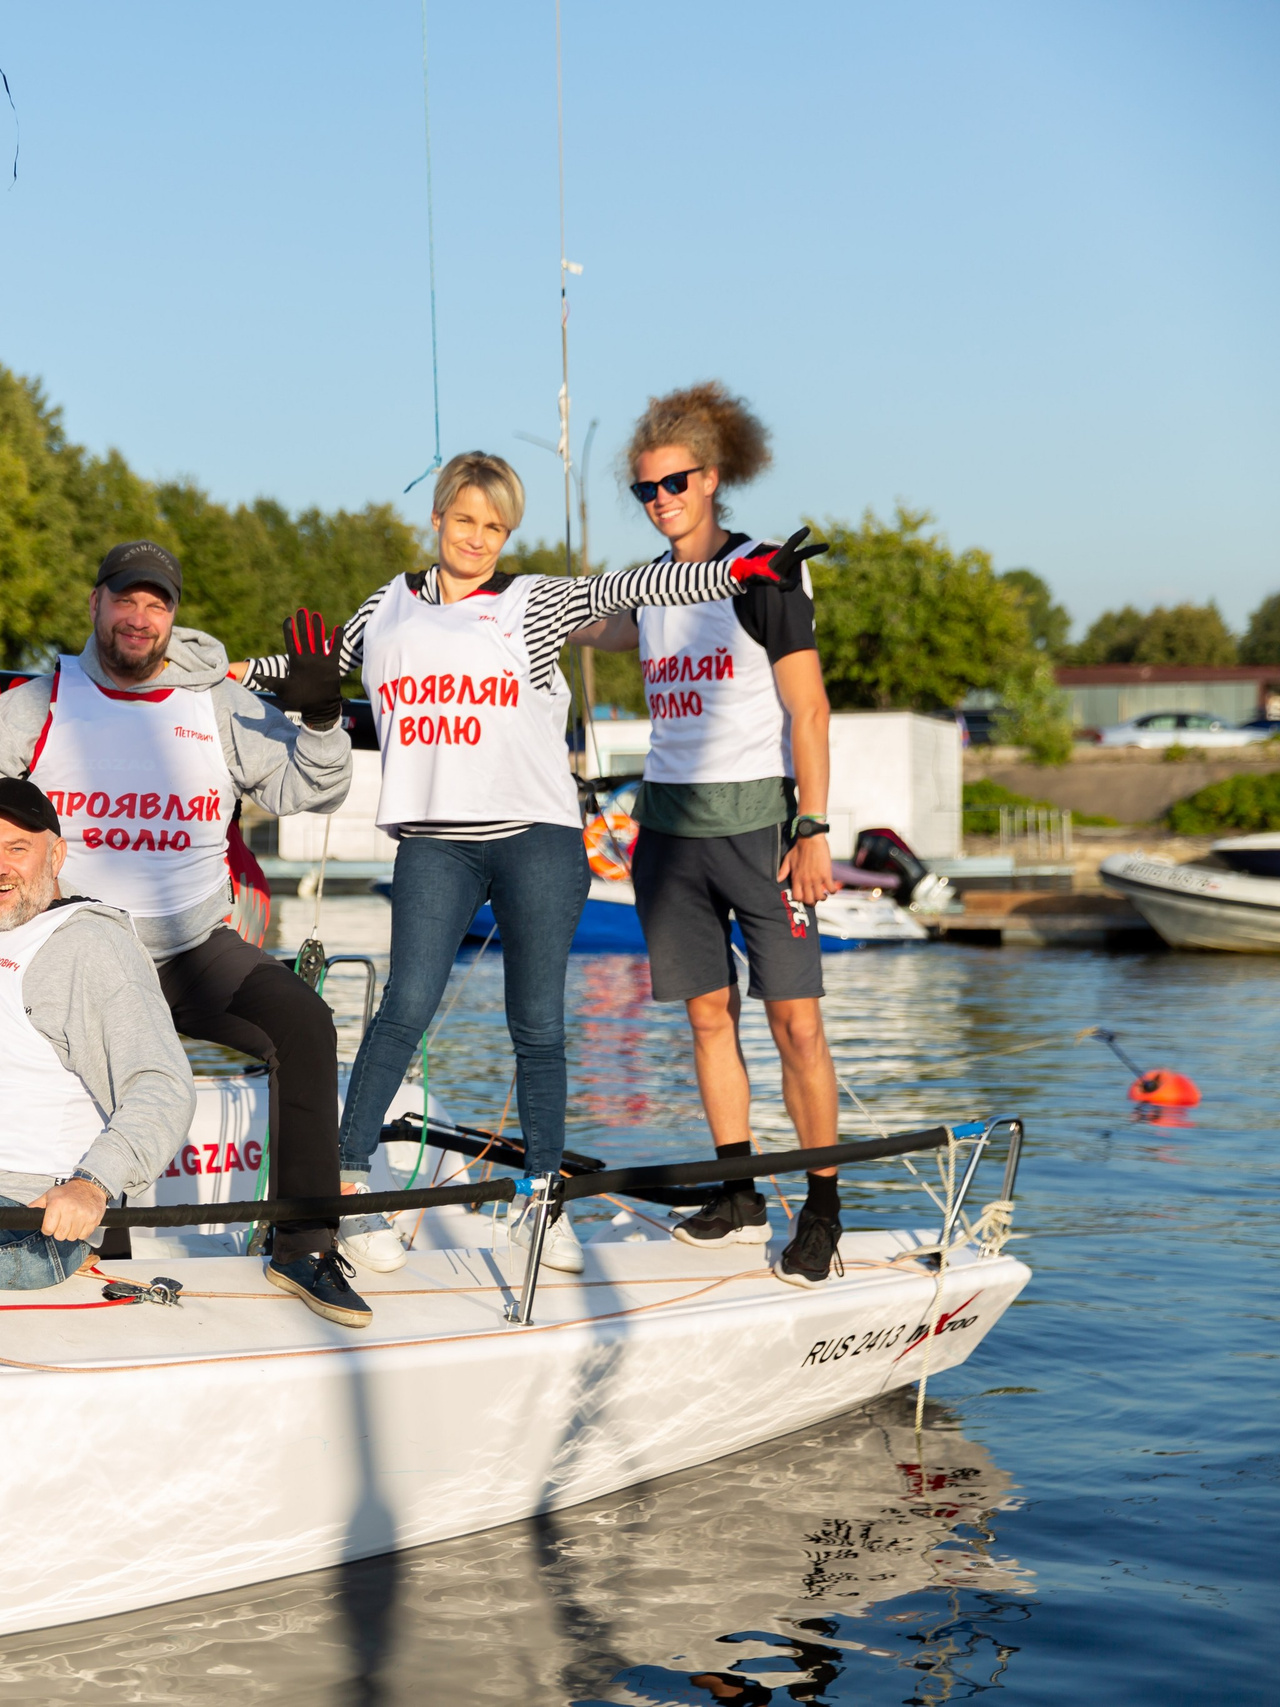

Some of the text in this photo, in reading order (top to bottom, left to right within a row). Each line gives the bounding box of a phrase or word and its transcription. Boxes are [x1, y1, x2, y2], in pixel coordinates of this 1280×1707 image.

[642, 646, 734, 686] РОЯВЛЯЙ
[399, 715, 481, 747] ВОЛЮ
[46, 788, 221, 822] ПРОЯВЛЯЙ
[82, 827, 191, 852] ВОЛЮ
[160, 1140, 264, 1178] IGZAG
[800, 1334, 856, 1368] RUS
[851, 1324, 907, 1357] 2413
